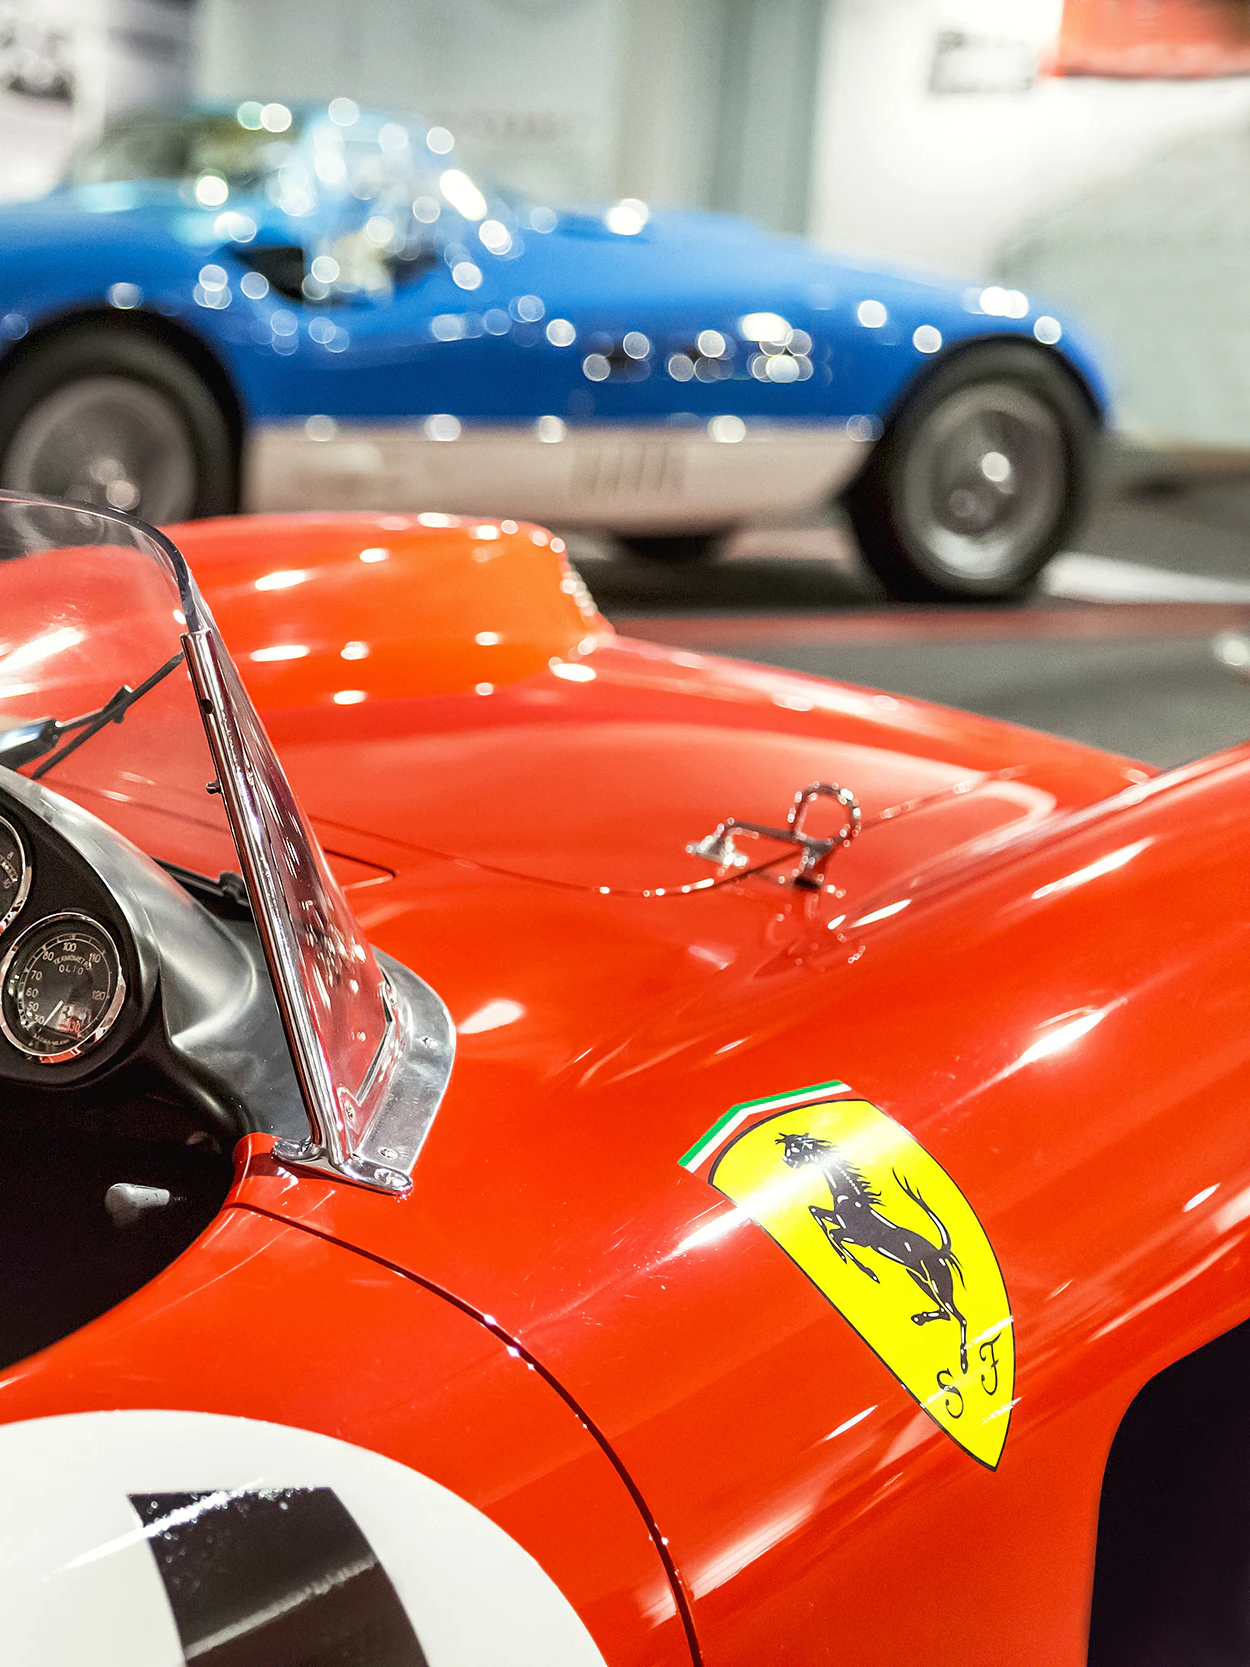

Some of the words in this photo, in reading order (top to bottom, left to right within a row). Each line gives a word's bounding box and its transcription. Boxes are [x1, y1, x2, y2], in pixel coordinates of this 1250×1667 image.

[62, 941, 78, 953] 100
[41, 949, 55, 962] 80
[87, 951, 102, 965] 110
[30, 970, 43, 982] 70
[58, 963, 85, 976] OLIO
[26, 987, 39, 999] 60
[91, 990, 106, 1003] 120
[26, 1001, 40, 1013] 50
[33, 1013, 46, 1026] 30
[936, 1367, 965, 1420] S
